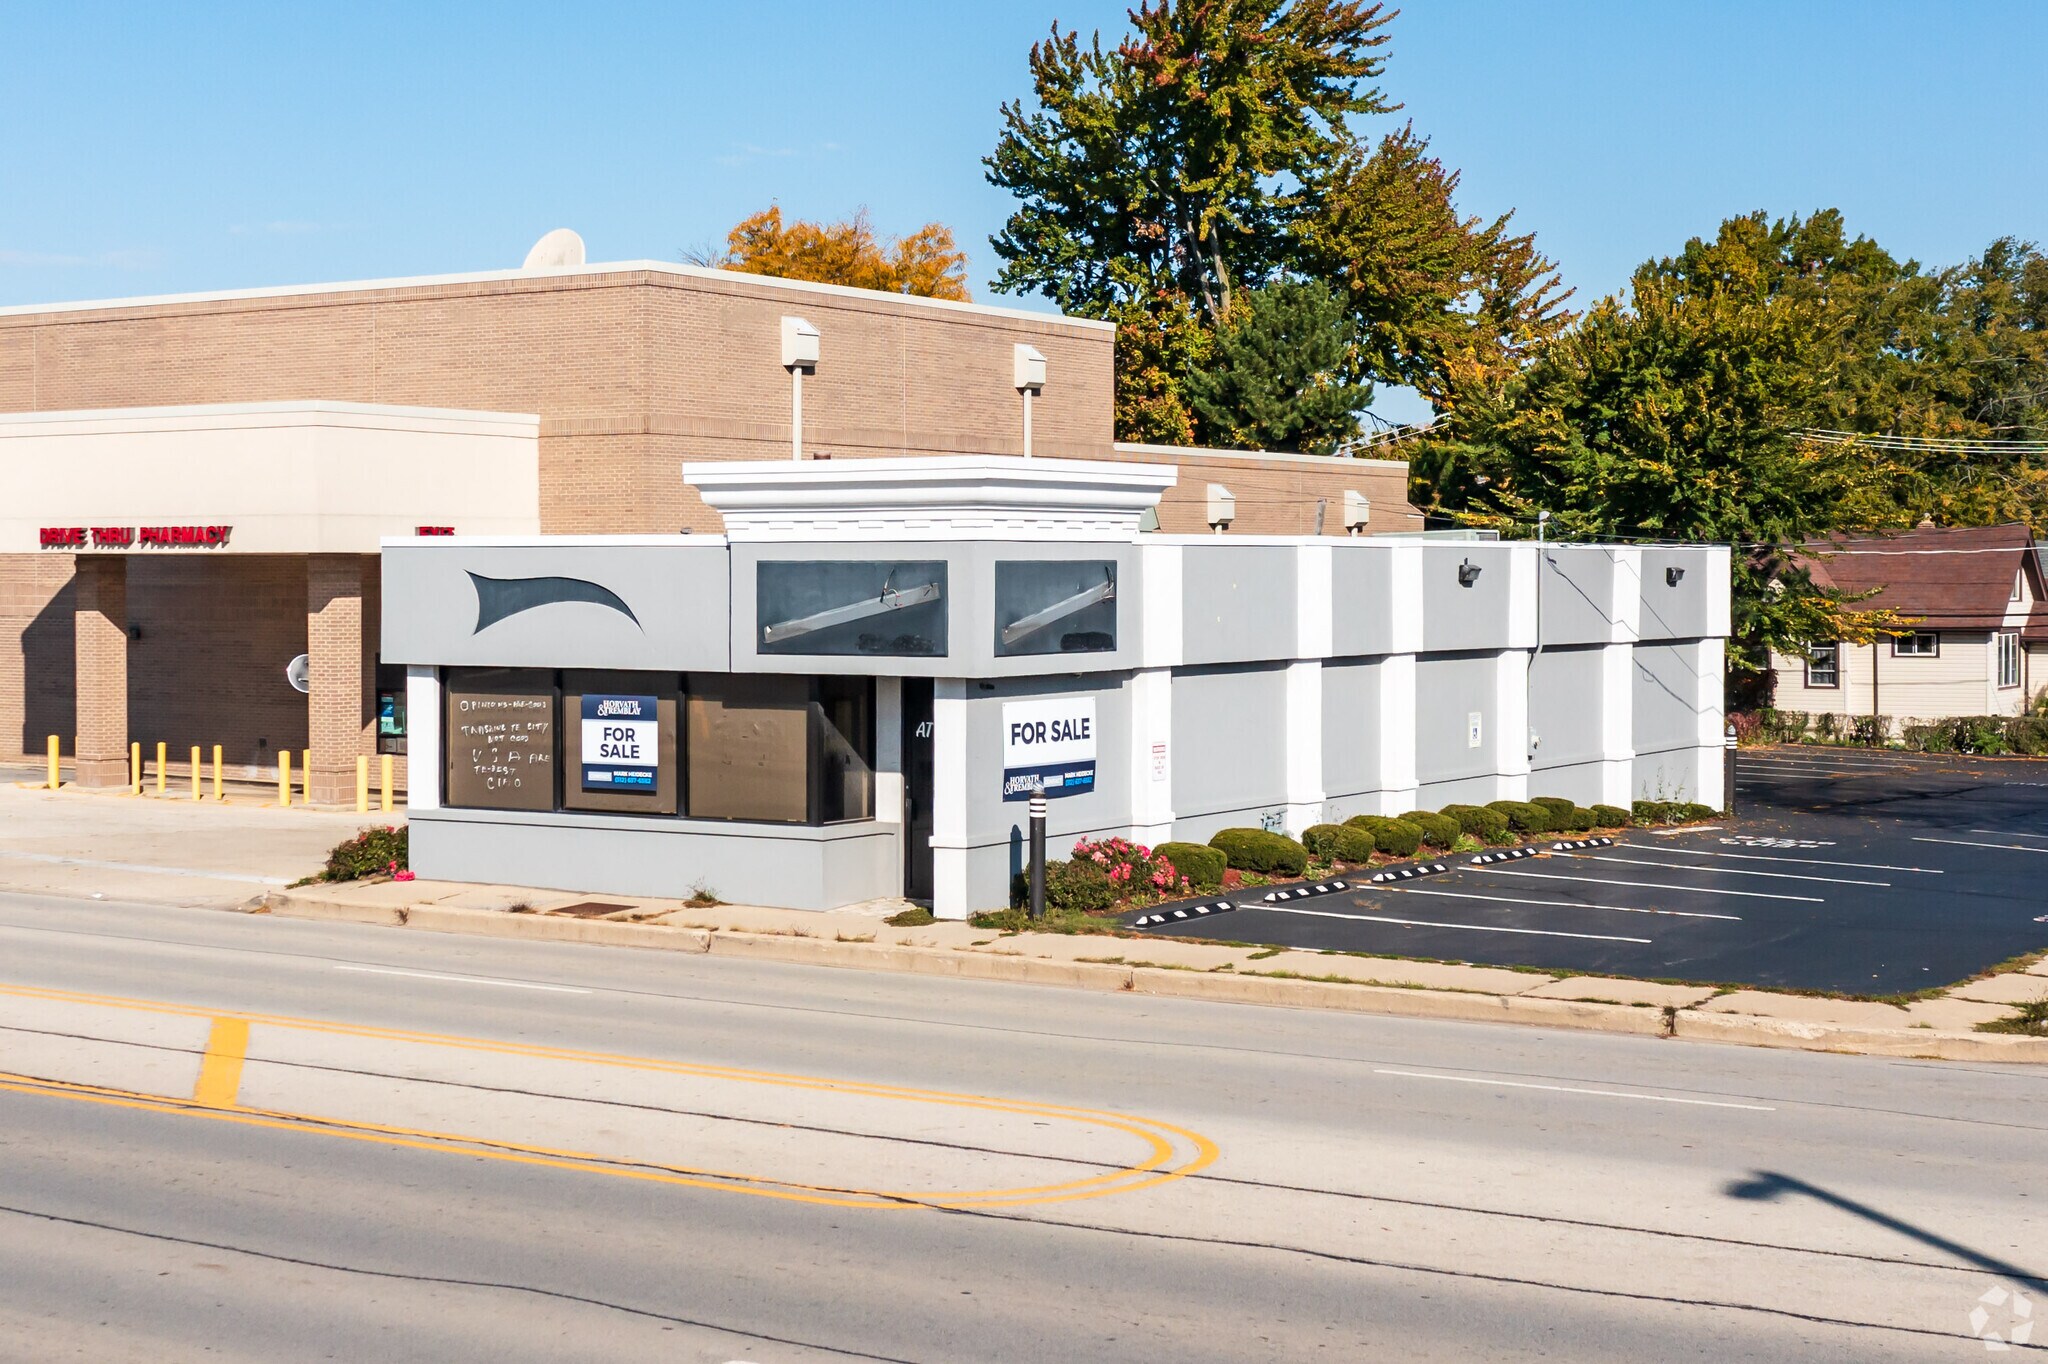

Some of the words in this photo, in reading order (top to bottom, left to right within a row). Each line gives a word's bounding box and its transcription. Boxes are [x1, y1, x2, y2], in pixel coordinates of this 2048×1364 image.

[40, 527, 85, 544] DRIVE
[90, 527, 132, 544] THRU
[139, 526, 229, 544] PHARMACY
[603, 700, 638, 708] HORVATH
[603, 727, 635, 742] FOR
[1011, 721, 1047, 746] FOR
[1051, 717, 1090, 742] SALE
[600, 744, 640, 759] SALE
[1010, 774, 1039, 784] HORVATH
